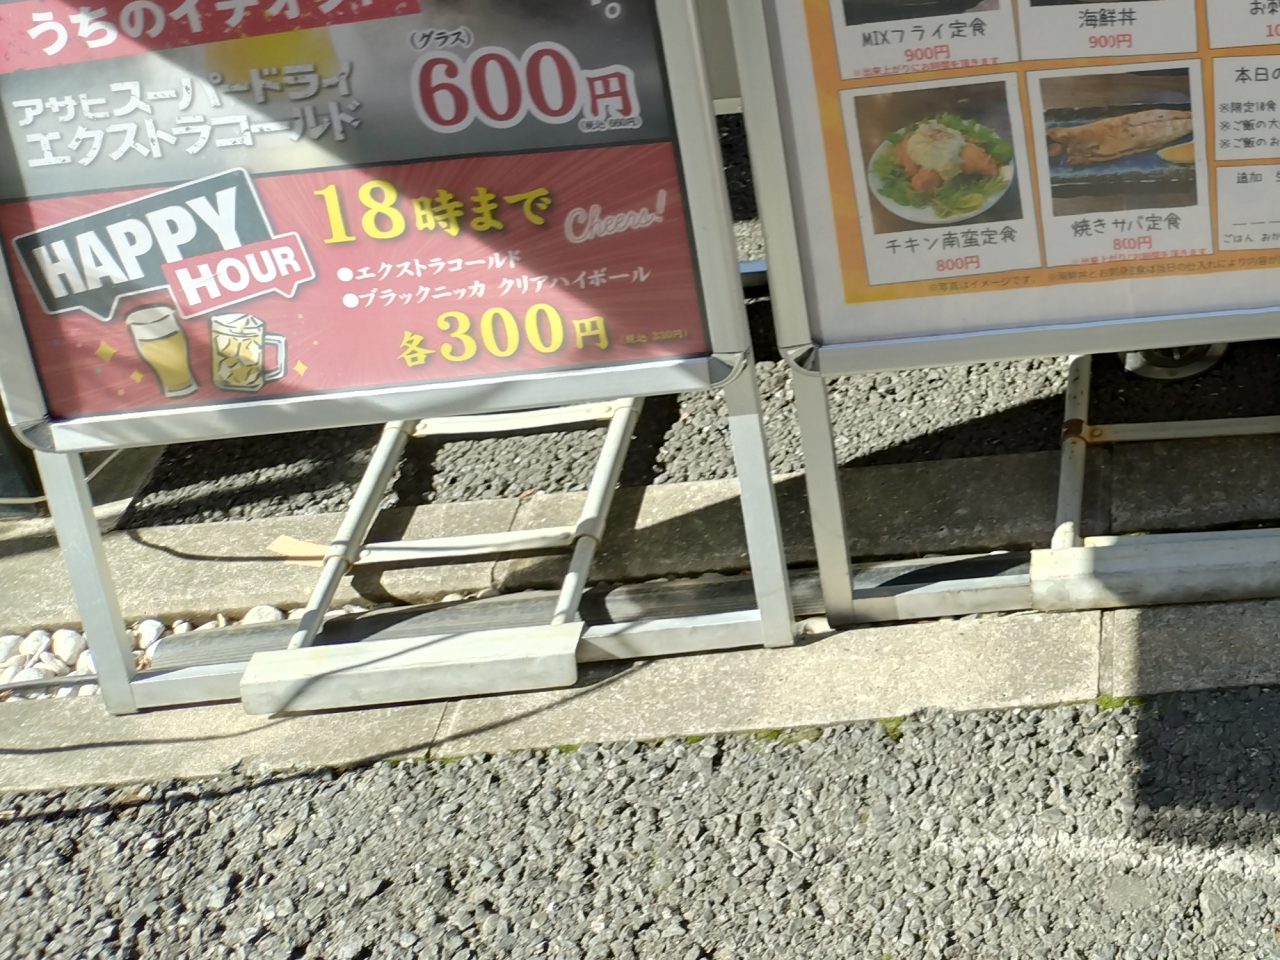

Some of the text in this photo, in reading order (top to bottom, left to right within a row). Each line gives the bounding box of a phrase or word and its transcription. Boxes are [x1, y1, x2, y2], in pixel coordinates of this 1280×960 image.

[861, 17, 988, 48] MIXフライ定食
[1077, 7, 1138, 29] 海鮮丼
[903, 43, 951, 62] 900円
[1088, 32, 1133, 50] 900円
[12, 61, 353, 127] アサヒスーパードライ
[418, 47, 633, 127] 600円
[26, 99, 362, 168] エクストラコールド
[1236, 171, 1263, 184] 追加
[313, 179, 553, 245] 18時まで
[564, 189, 667, 244] Cheers!
[1070, 212, 1182, 238] 焼きサバ定食
[32, 186, 243, 300] HAPPY
[884, 225, 1018, 255] チキン南蛮定食
[175, 246, 302, 307] HOUR
[936, 254, 981, 272] 800円
[397, 303, 610, 368] 各300円
